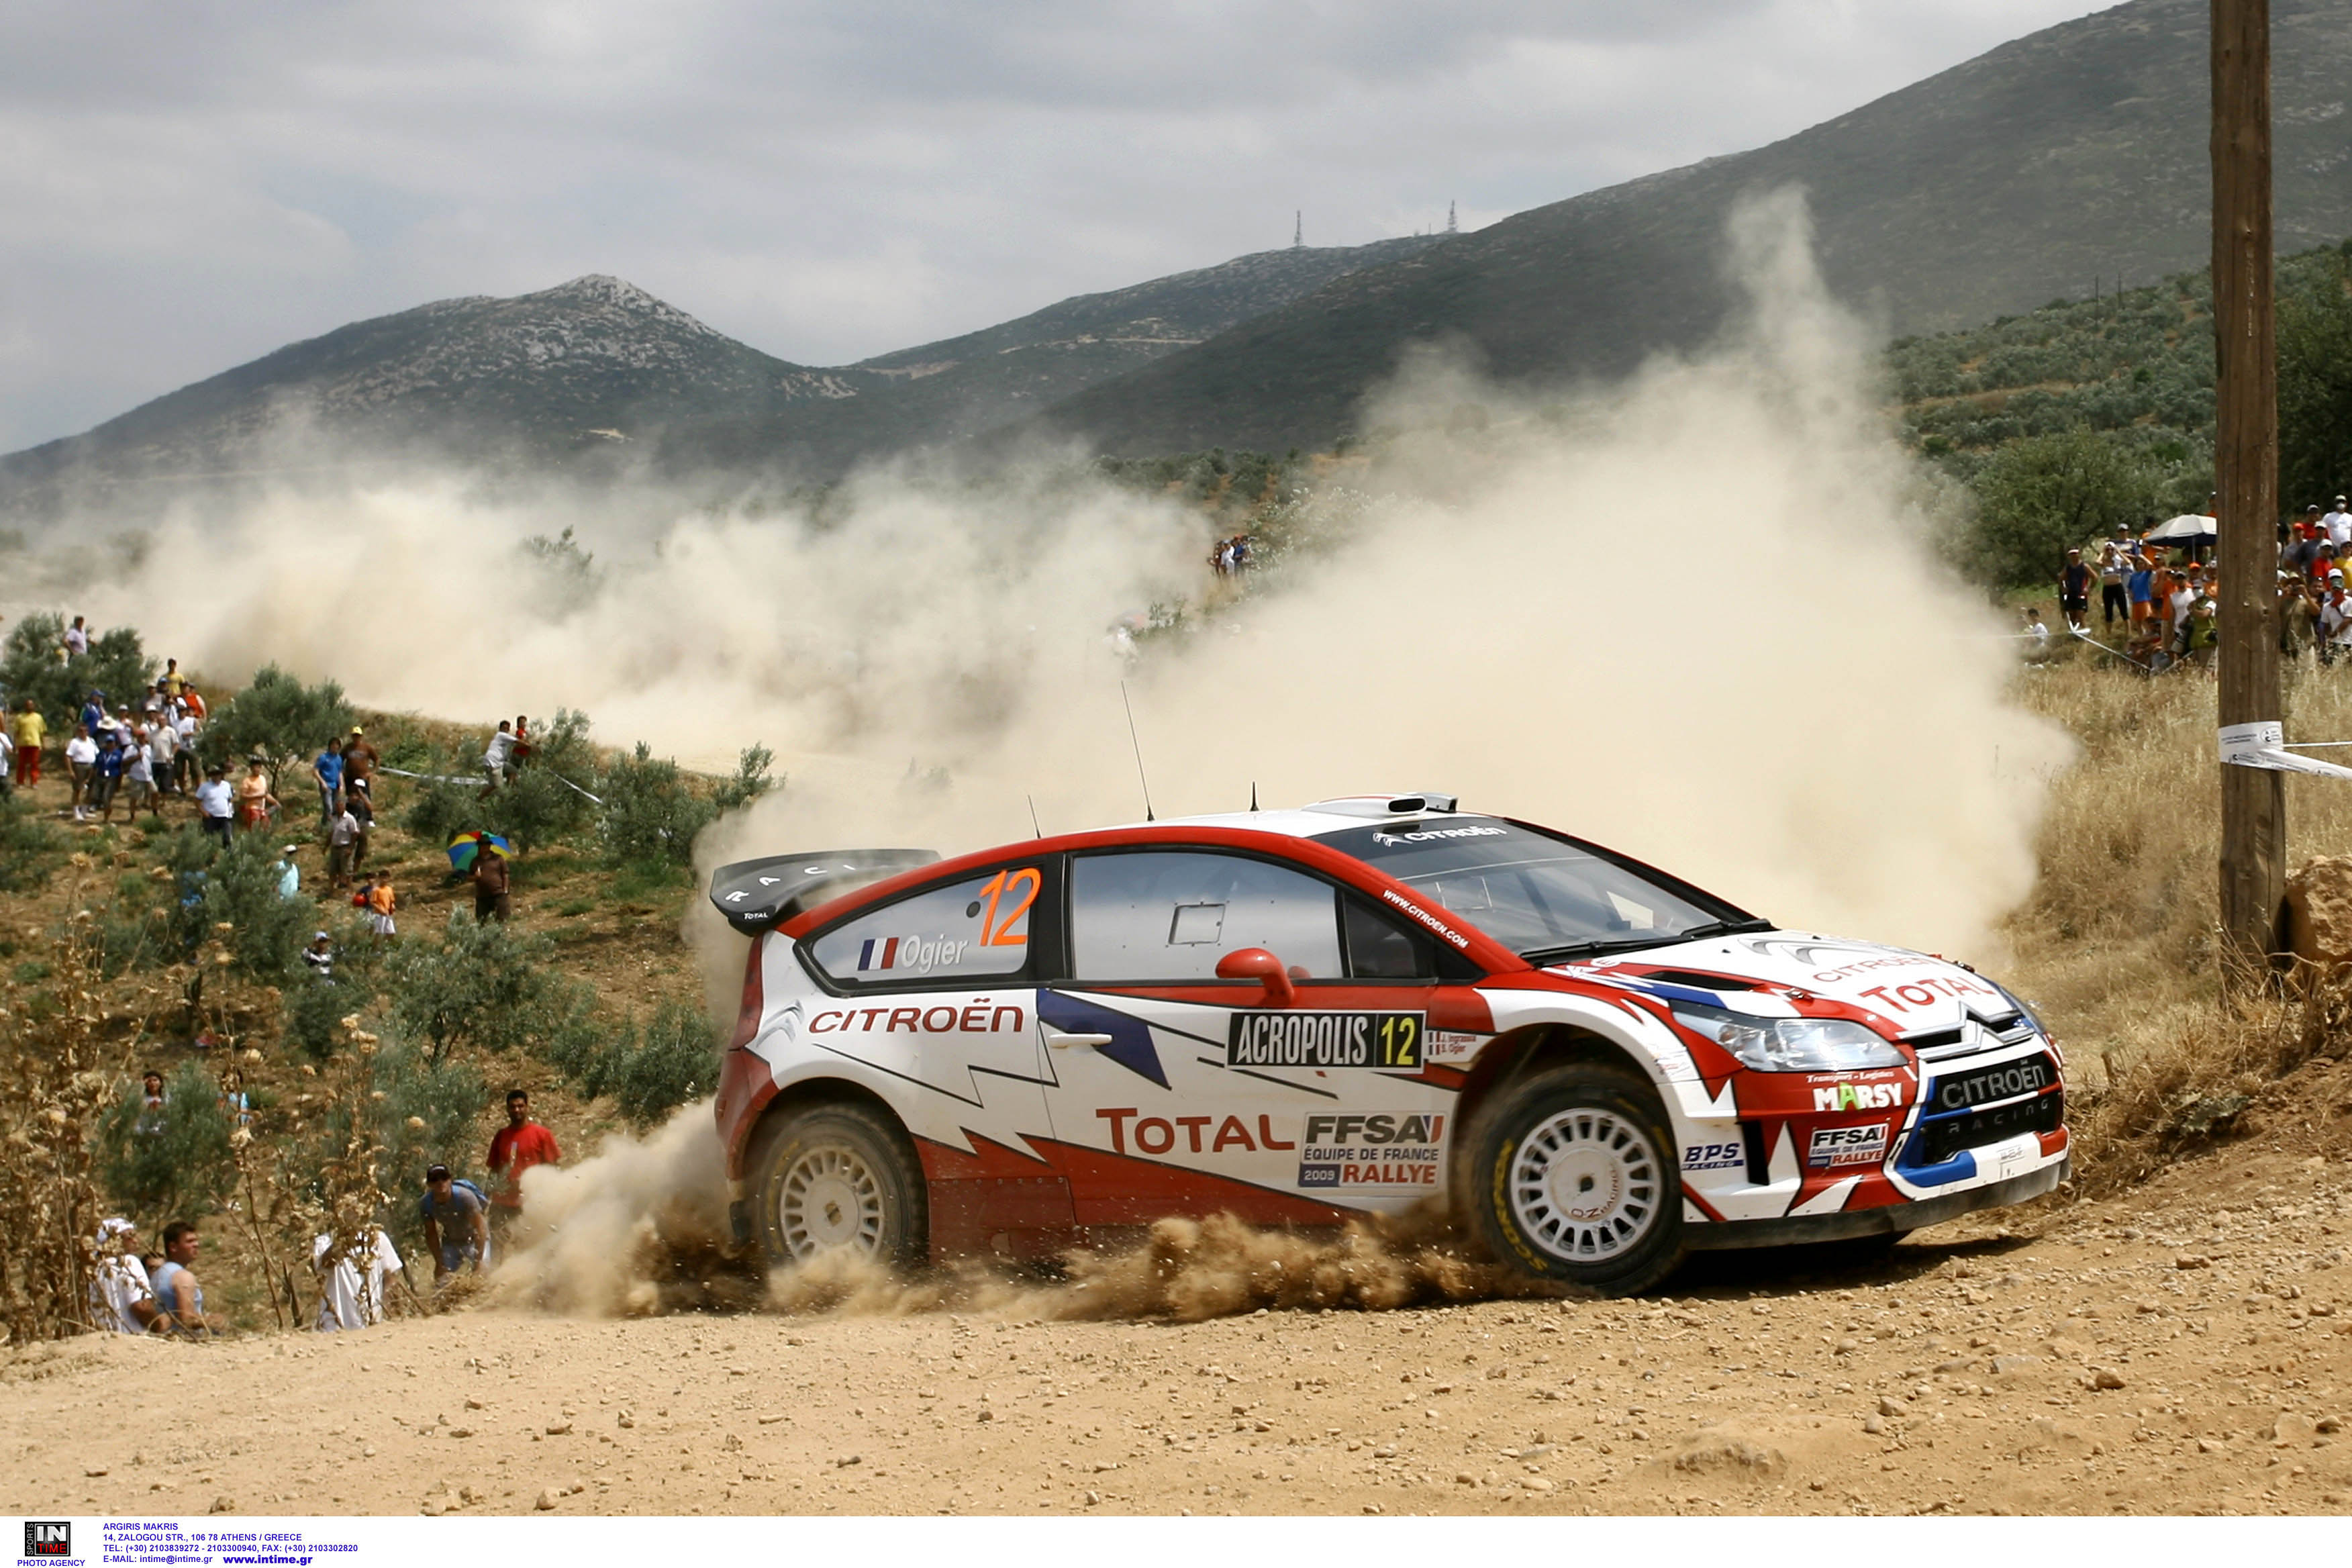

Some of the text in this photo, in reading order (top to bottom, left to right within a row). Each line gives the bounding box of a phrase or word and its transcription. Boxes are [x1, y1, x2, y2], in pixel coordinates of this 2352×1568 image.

[1405, 826, 1508, 841] CITROËN
[743, 912, 769, 920] TOTAL
[978, 867, 1042, 947] 12
[1383, 889, 1469, 949] WWW.CITROEN.COM
[900, 934, 970, 975] Ogier
[1857, 976, 1997, 1013] TOTAL
[808, 997, 1025, 1034] CITROËN
[1236, 1014, 1416, 1065] ACROPOLIS 12
[1813, 1082, 1902, 1112] MARSY
[1941, 1059, 2046, 1108] CITROËN
[1306, 1115, 1428, 1144] FFSA
[1949, 1098, 2049, 1134] RACING
[1095, 1108, 1296, 1155] TOTAL
[1813, 1128, 1879, 1146] FFSA
[1304, 1146, 1439, 1161] ÉQUIPE DE FRANCE
[1684, 1142, 1740, 1162] BPS
[1832, 1149, 1883, 1164] RALLYE
[1304, 1170, 1336, 1181] 2009
[1343, 1164, 1437, 1184] RALLYE
